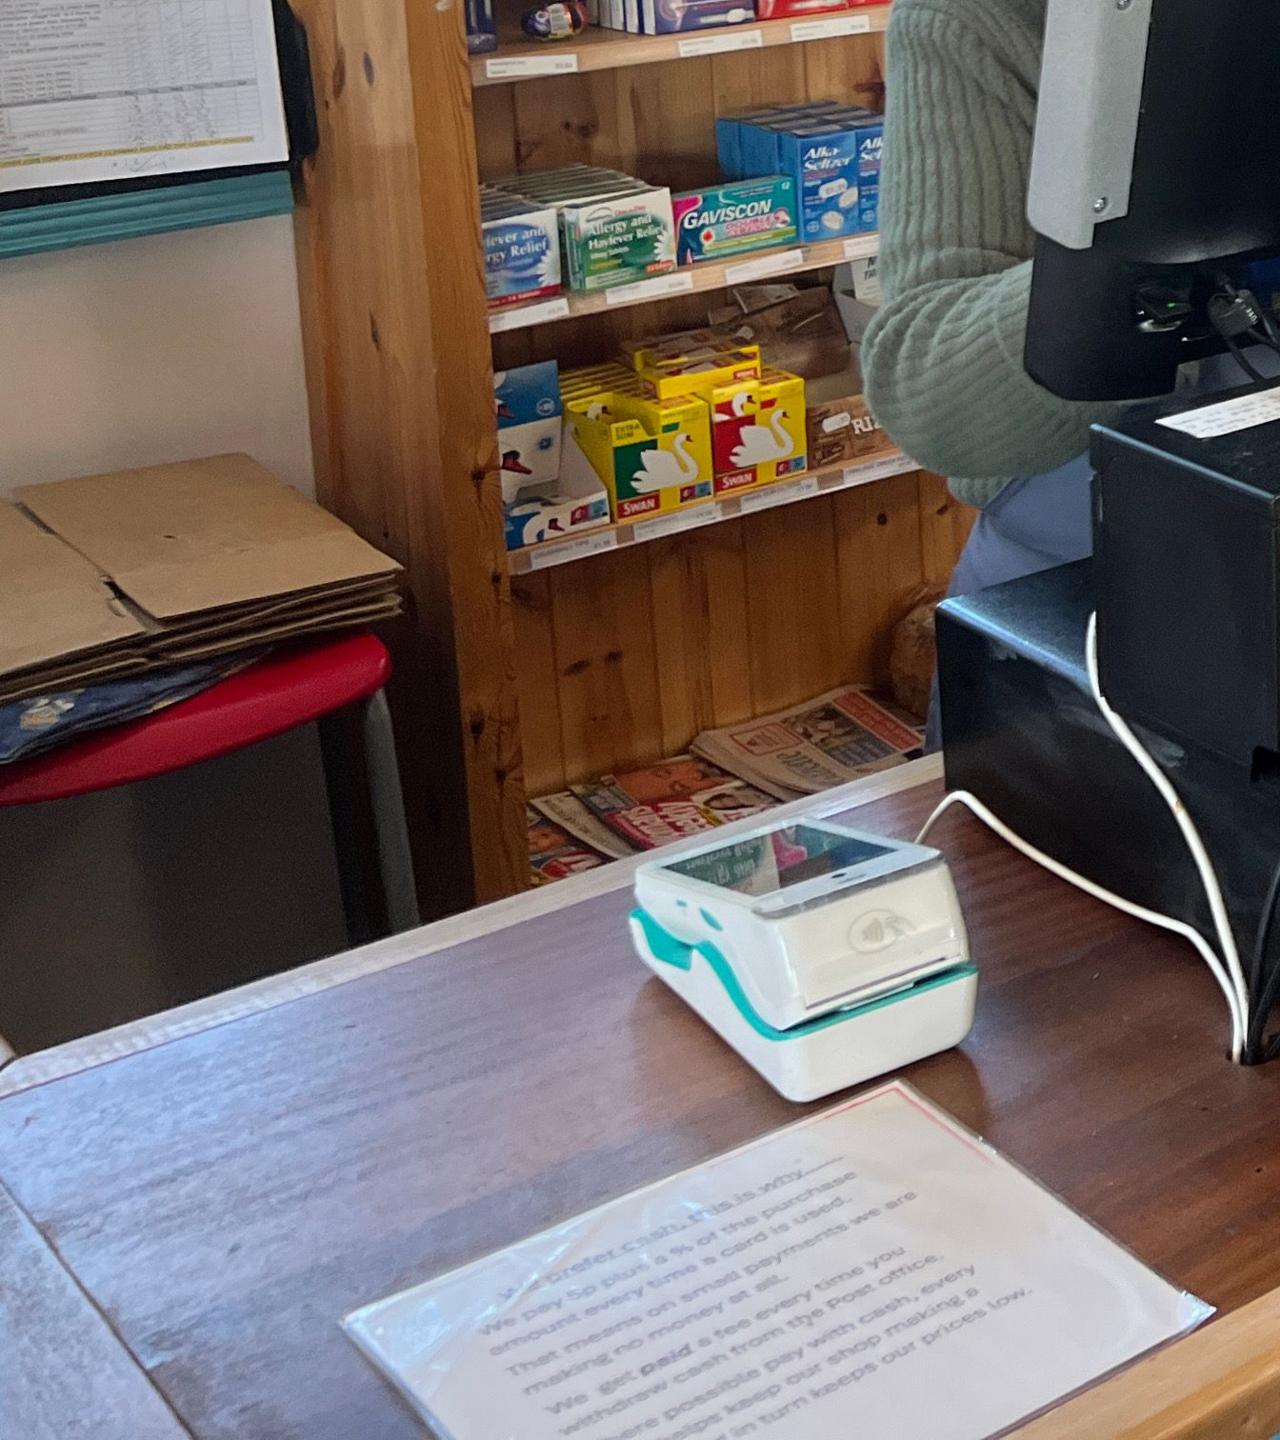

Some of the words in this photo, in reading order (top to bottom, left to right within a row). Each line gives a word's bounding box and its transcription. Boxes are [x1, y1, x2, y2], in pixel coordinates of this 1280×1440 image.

[804, 156, 851, 172] Seltzer
[511, 239, 548, 256] Relief
[589, 231, 633, 251] Hayfever
[591, 219, 625, 237] Allergy
[629, 214, 652, 229] and
[684, 198, 772, 230] GAVISCON
[622, 497, 656, 516] SWAN
[722, 471, 754, 489] SWAN
[506, 1350, 561, 1377] That
[563, 1315, 643, 1353] means
[680, 1270, 741, 1302] small
[744, 1222, 849, 1276] payments
[885, 1190, 918, 1211] are
[521, 1298, 563, 1322] pay
[761, 1171, 858, 1220] purchase
[489, 1313, 581, 1356] amount
[584, 1287, 644, 1316] every
[647, 1263, 698, 1288] time
[721, 1231, 767, 1257] card
[640, 1343, 693, 1377] paid
[755, 1289, 813, 1321] every
[814, 1264, 865, 1292] time
[866, 1246, 906, 1270] you
[523, 1353, 613, 1396] making
[647, 1302, 725, 1340] money
[558, 1381, 668, 1436] withdraw
[673, 1354, 730, 1383] cash
[730, 1326, 786, 1356] from
[786, 1307, 825, 1328] the
[825, 1284, 877, 1310] Post
[664, 1368, 761, 1421] possible
[763, 1347, 805, 1373] pay
[806, 1323, 857, 1350] with
[920, 1263, 977, 1295] every
[758, 1396, 808, 1424] turn
[807, 1362, 880, 1400] keeps
[880, 1341, 917, 1365] our
[920, 1310, 988, 1345] prices
[784, 1362, 822, 1385] our
[826, 1334, 882, 1365] shop
[884, 1296, 966, 1337] making
